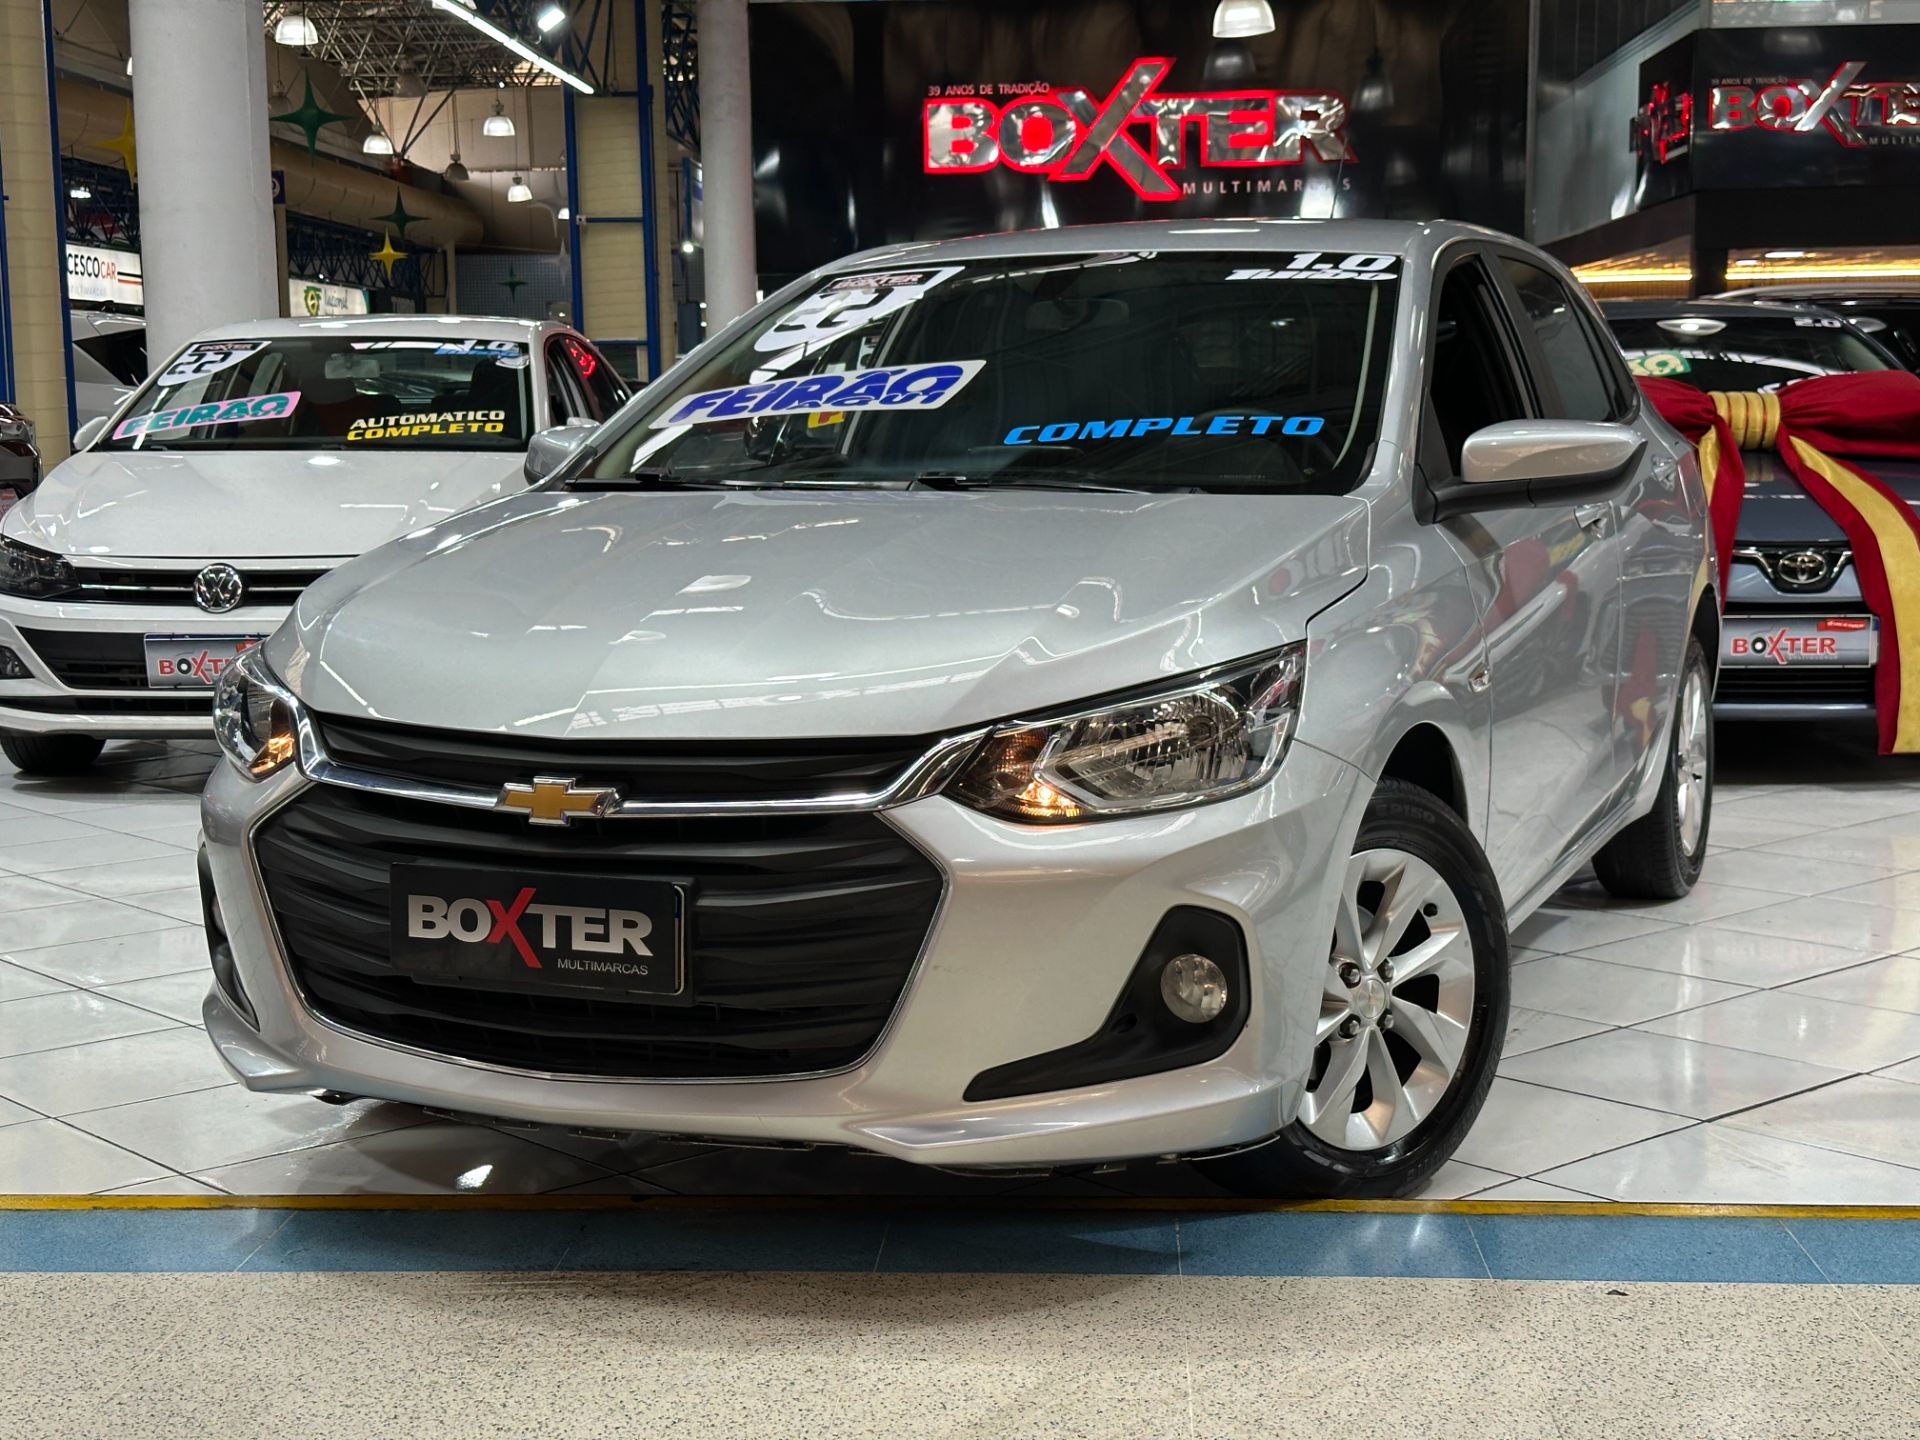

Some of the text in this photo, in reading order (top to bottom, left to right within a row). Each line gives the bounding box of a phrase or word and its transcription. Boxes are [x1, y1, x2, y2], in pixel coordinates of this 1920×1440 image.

[928, 79, 1050, 96] 39 ANOS DE TRADIÇÃO
[923, 56, 1359, 202] BOXTER
[1286, 252, 1397, 271] 1.0
[832, 274, 923, 289] BOXTER
[1793, 317, 1841, 328] 2.0
[166, 351, 233, 375] 22
[350, 410, 505, 429] AUTOMATICO
[347, 422, 504, 441] COMPLETO
[1003, 416, 1325, 445] COMPLETO
[1731, 628, 1837, 664] BOXTER
[408, 887, 653, 969] BOXTER
[557, 957, 648, 976] MULTIMARCAS
